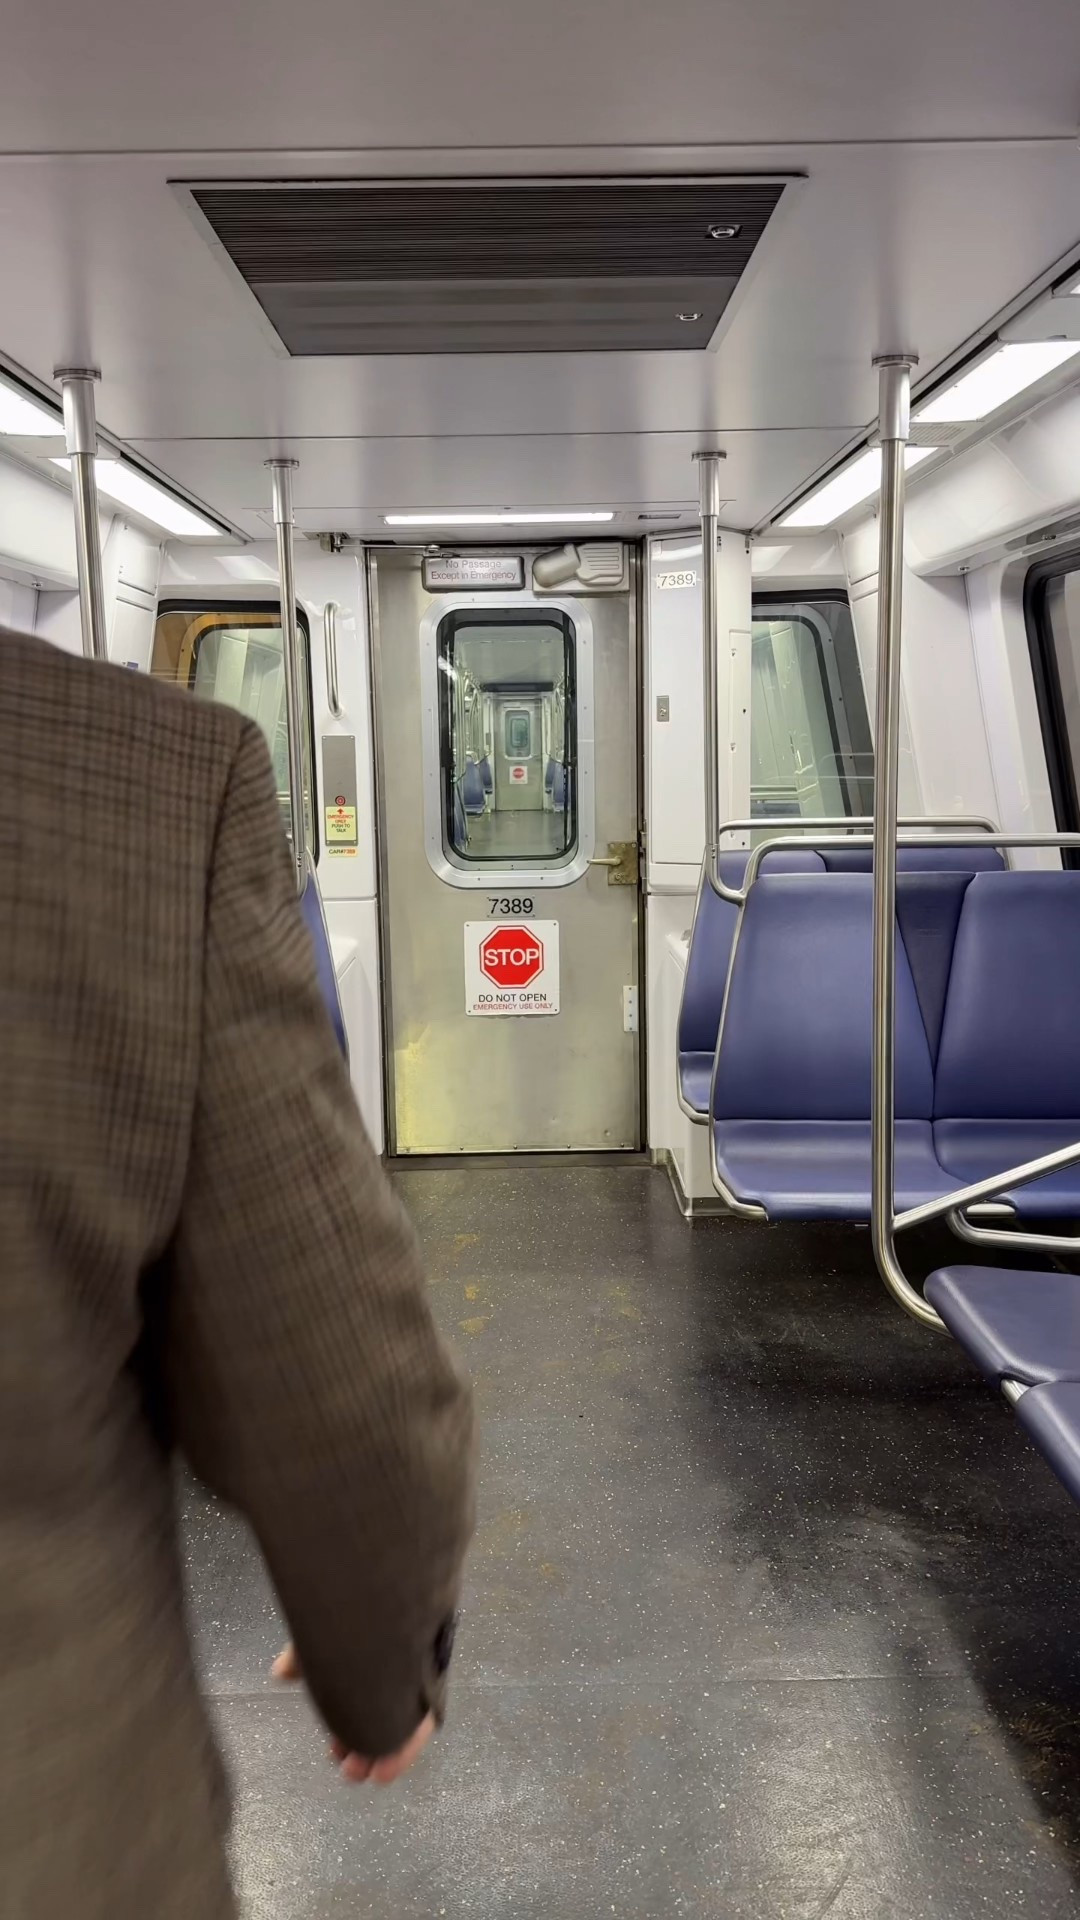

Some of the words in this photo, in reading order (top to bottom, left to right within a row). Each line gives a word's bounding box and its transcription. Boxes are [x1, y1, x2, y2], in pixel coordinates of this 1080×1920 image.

[445, 560, 459, 569] No
[462, 560, 502, 570] Passage
[431, 571, 460, 581] Except
[461, 571, 468, 579] in
[470, 571, 516, 581] Emergency
[660, 573, 693, 587] 7389
[488, 898, 534, 914] 7389
[484, 948, 539, 966] STOP
[478, 994, 493, 1003] DO
[495, 994, 516, 1002] NOT
[519, 993, 547, 1002] OPEN
